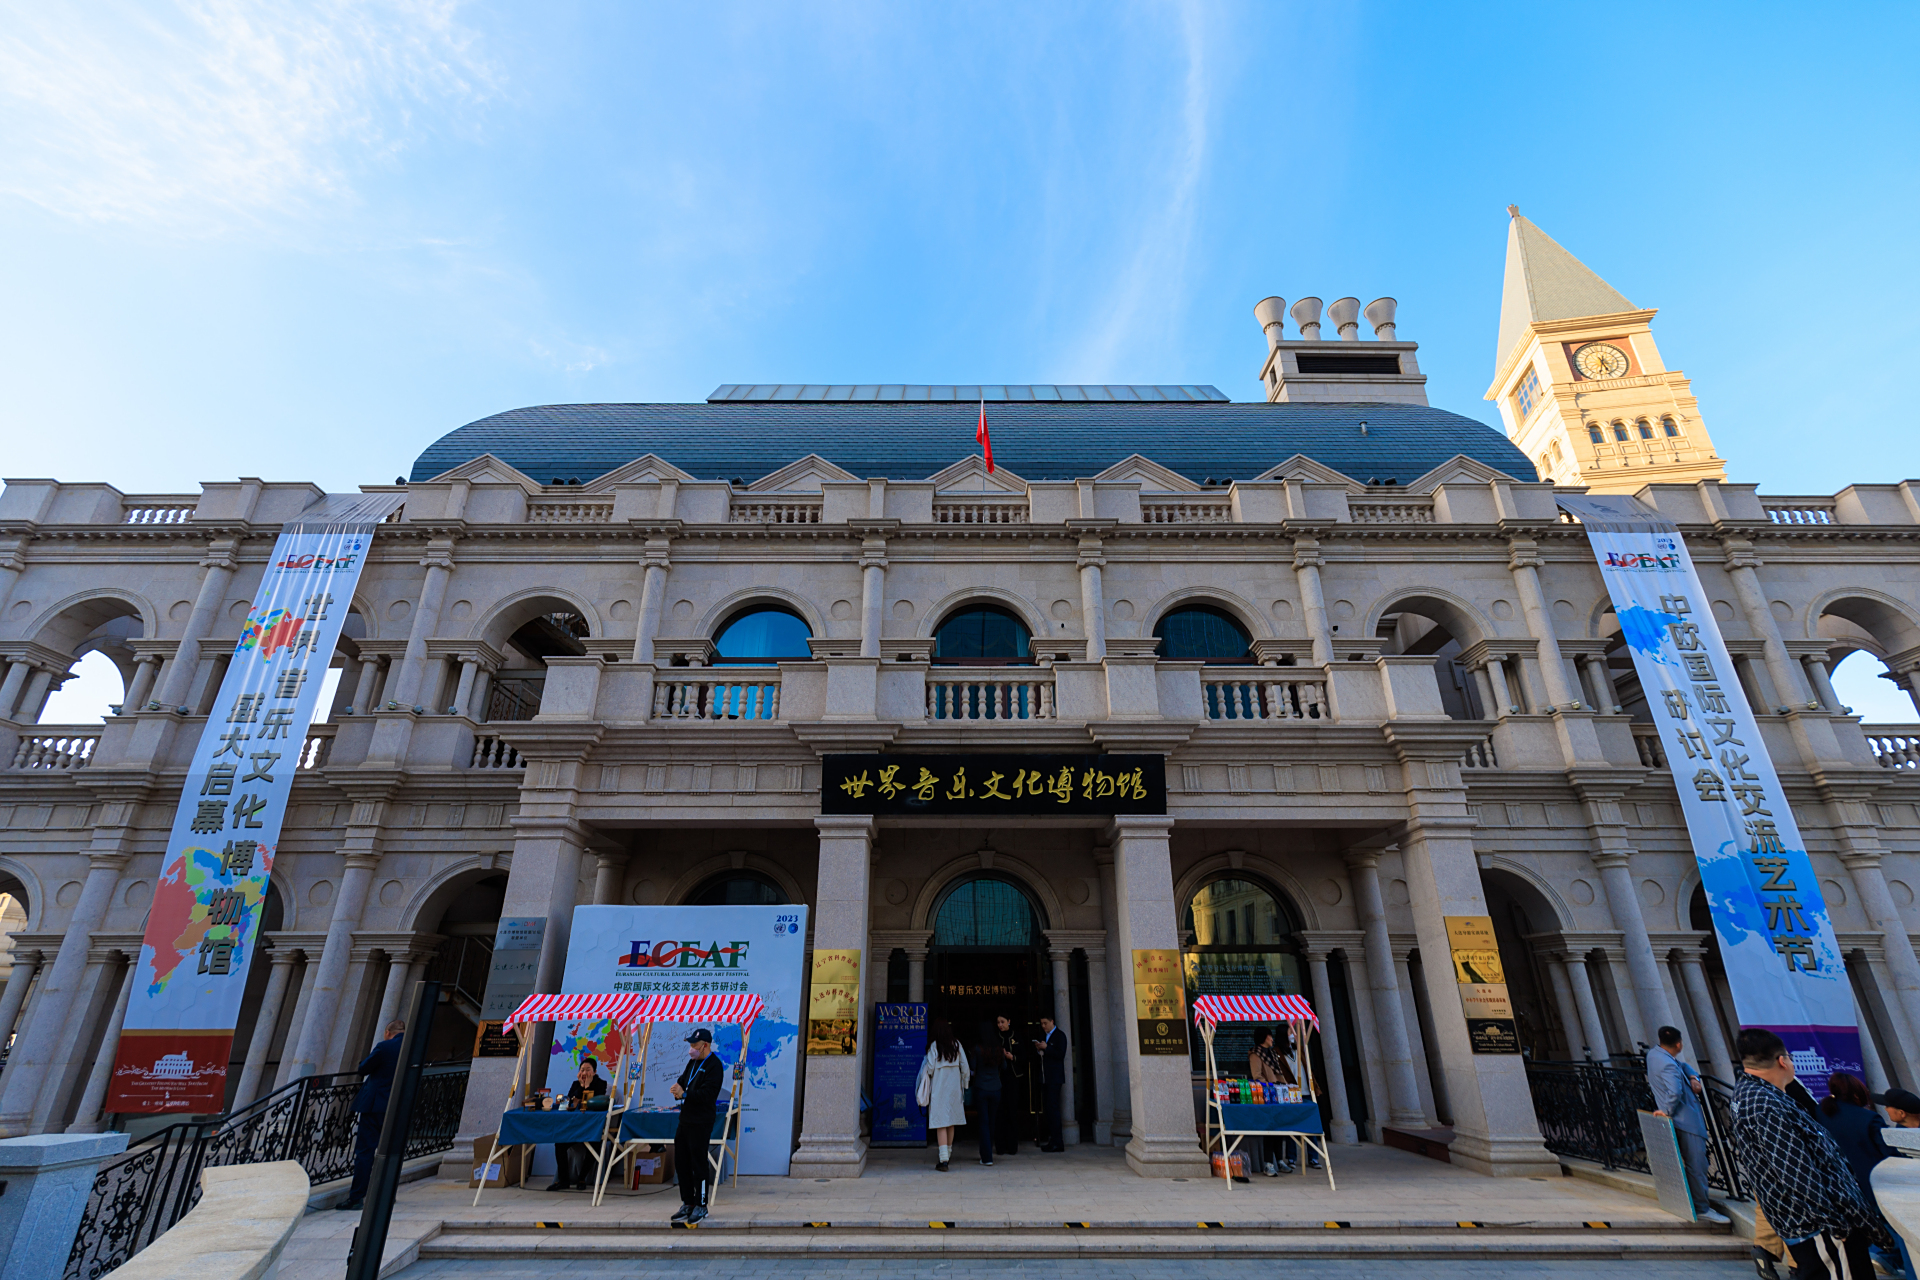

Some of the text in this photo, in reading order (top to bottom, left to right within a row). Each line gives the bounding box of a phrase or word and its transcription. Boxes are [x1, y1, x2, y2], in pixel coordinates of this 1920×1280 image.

[282, 554, 358, 569] ECEAF
[1606, 552, 1681, 569] ECEAF
[1660, 688, 1727, 803] 研讨会
[190, 692, 265, 834] 盛大启幕
[197, 592, 334, 975] 世界音乐文化博物馆
[839, 765, 1148, 803] 世界音乐文化博物馆
[1659, 593, 1817, 972] 中欧国际文化交流艺术节
[626, 940, 750, 968] ECEAF
[815, 954, 858, 969] 辽宁省科普基地
[613, 981, 749, 992] 中欧国际文化交流艺术节研讨会
